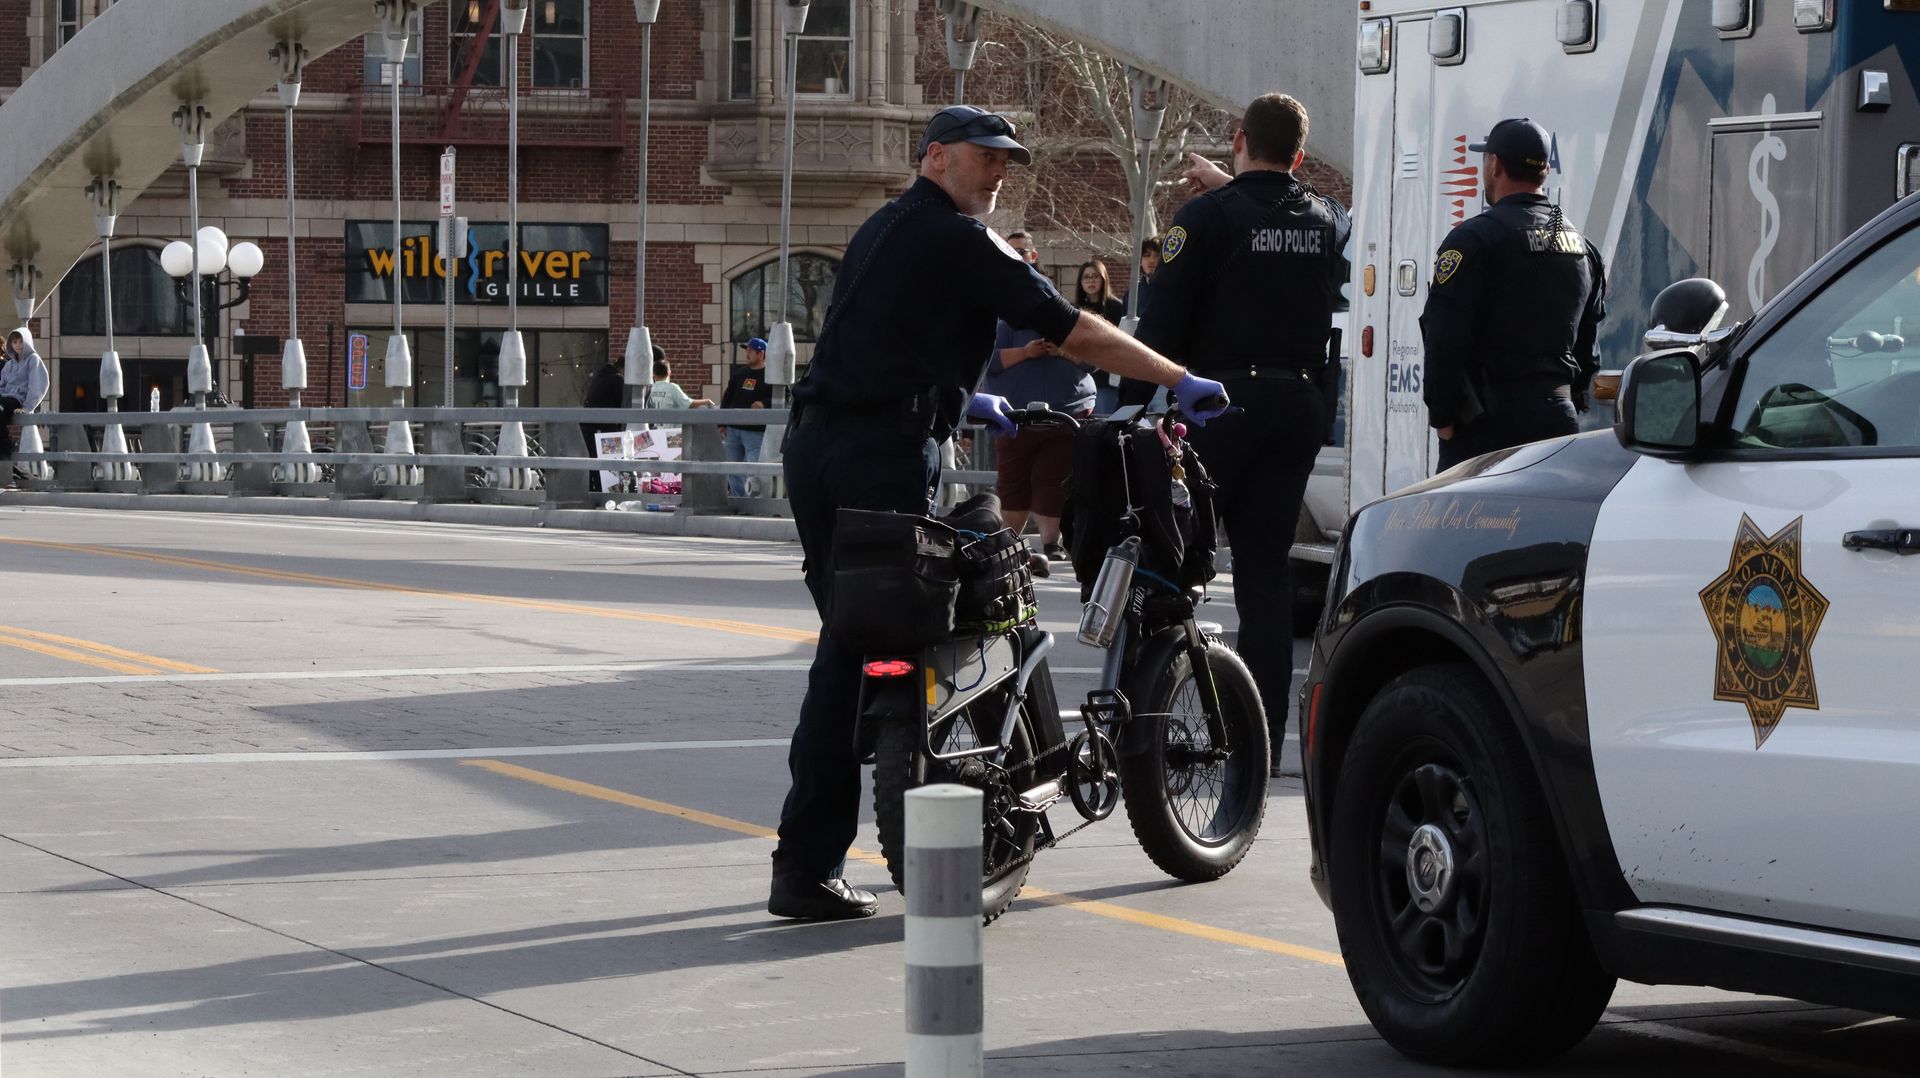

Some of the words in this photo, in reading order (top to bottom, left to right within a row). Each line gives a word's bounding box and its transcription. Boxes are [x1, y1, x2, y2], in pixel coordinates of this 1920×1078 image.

[1252, 228, 1283, 252] RENO
[1285, 229, 1321, 253] POLICE
[352, 337, 364, 385] OPEN
[1392, 340, 1419, 360] Regional
[1389, 363, 1421, 393] EMS
[1388, 399, 1420, 414] Authority
[1441, 500, 1465, 530] Our
[1465, 500, 1521, 540] Community
[1761, 555, 1802, 627] NEVADA
[1734, 664, 1795, 699] POLICE
